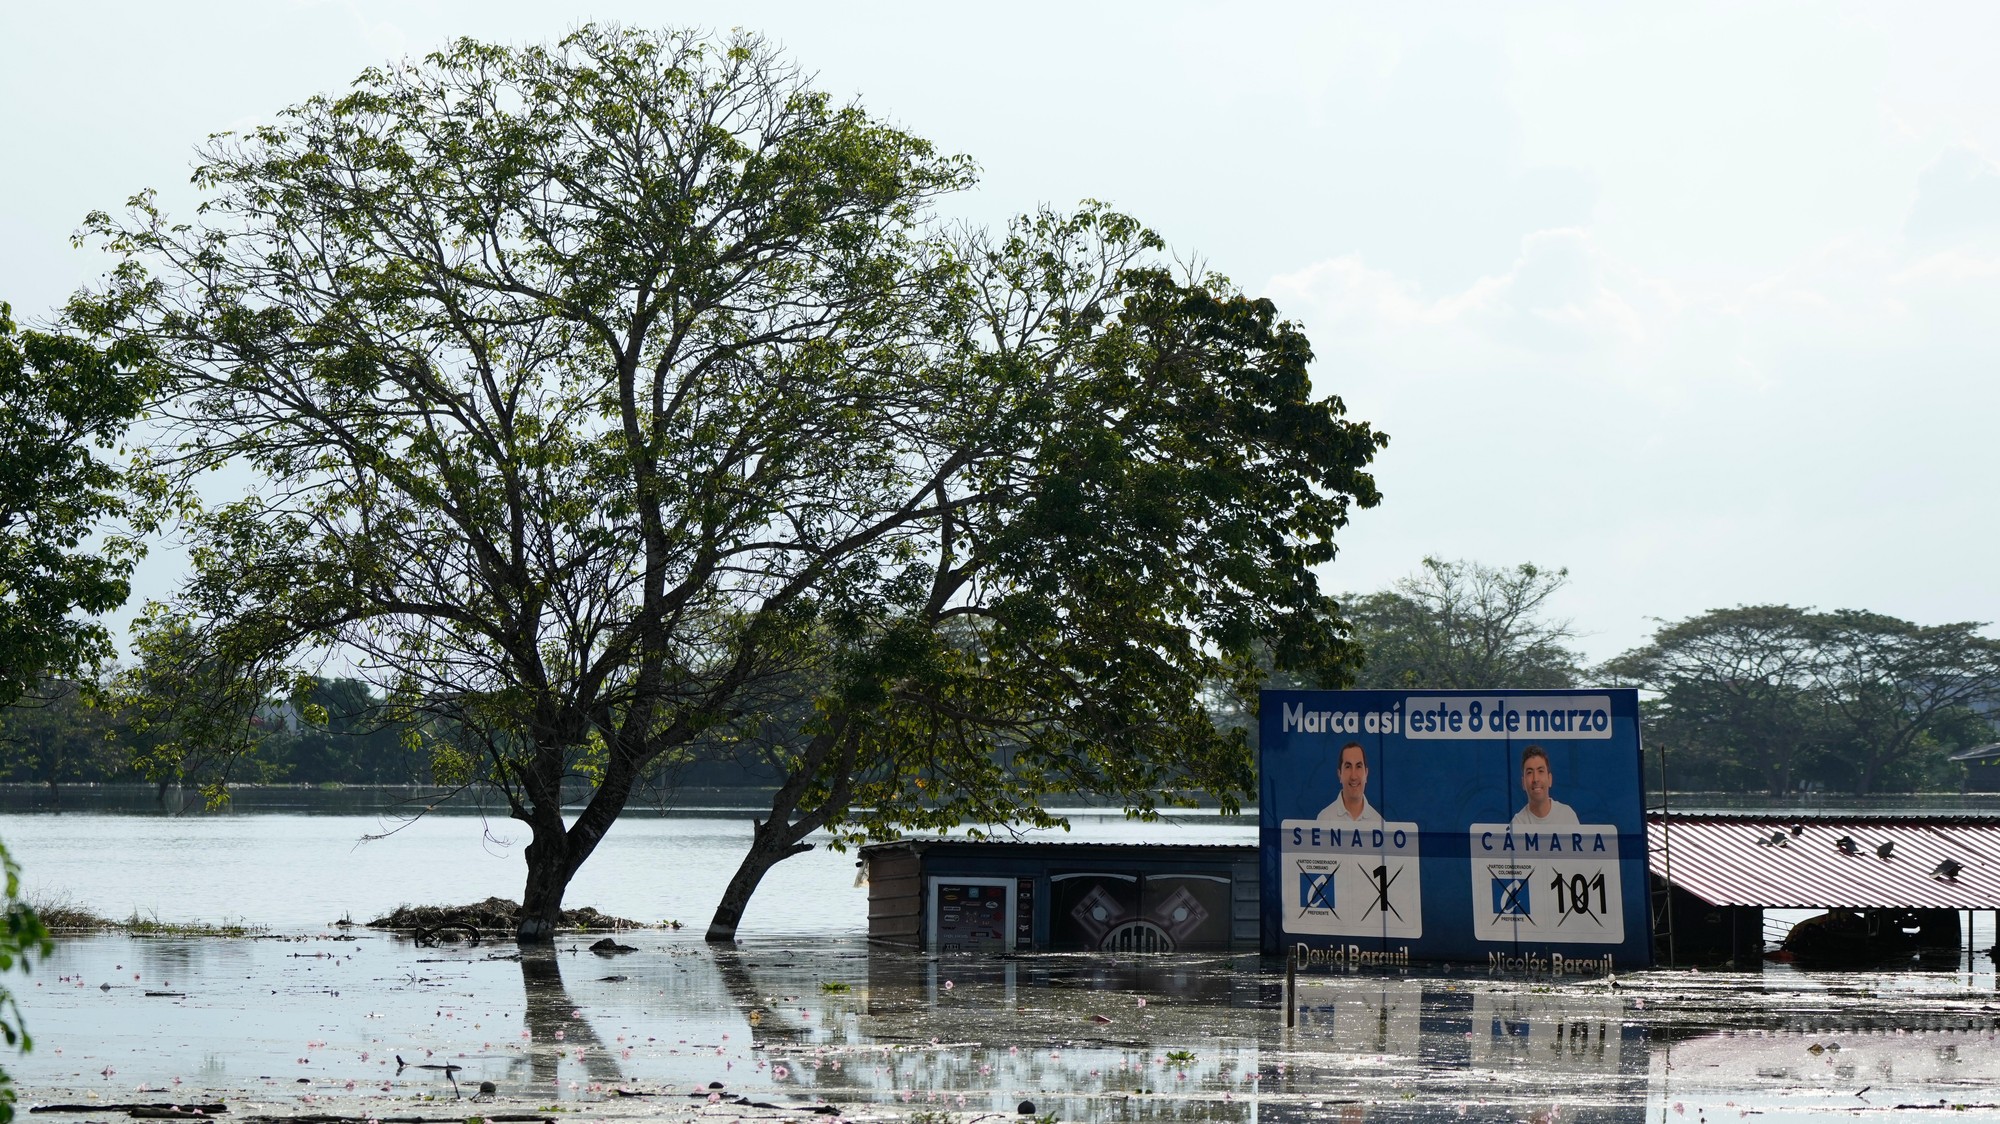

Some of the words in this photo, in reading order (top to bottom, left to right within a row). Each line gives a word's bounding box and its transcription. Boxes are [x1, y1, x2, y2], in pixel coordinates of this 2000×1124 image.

[1283, 702, 1358, 734] Marca
[1364, 701, 1400, 734] así
[1410, 702, 1463, 733] este
[1469, 700, 1484, 732] 8
[1490, 700, 1520, 733] de
[1526, 708, 1609, 733] marzo
[1293, 827, 1407, 849] SENADO
[1481, 826, 1606, 851] CÁMARA
[1372, 865, 1388, 911] 1
[1551, 873, 1607, 915] 101
[1297, 942, 1345, 963] David
